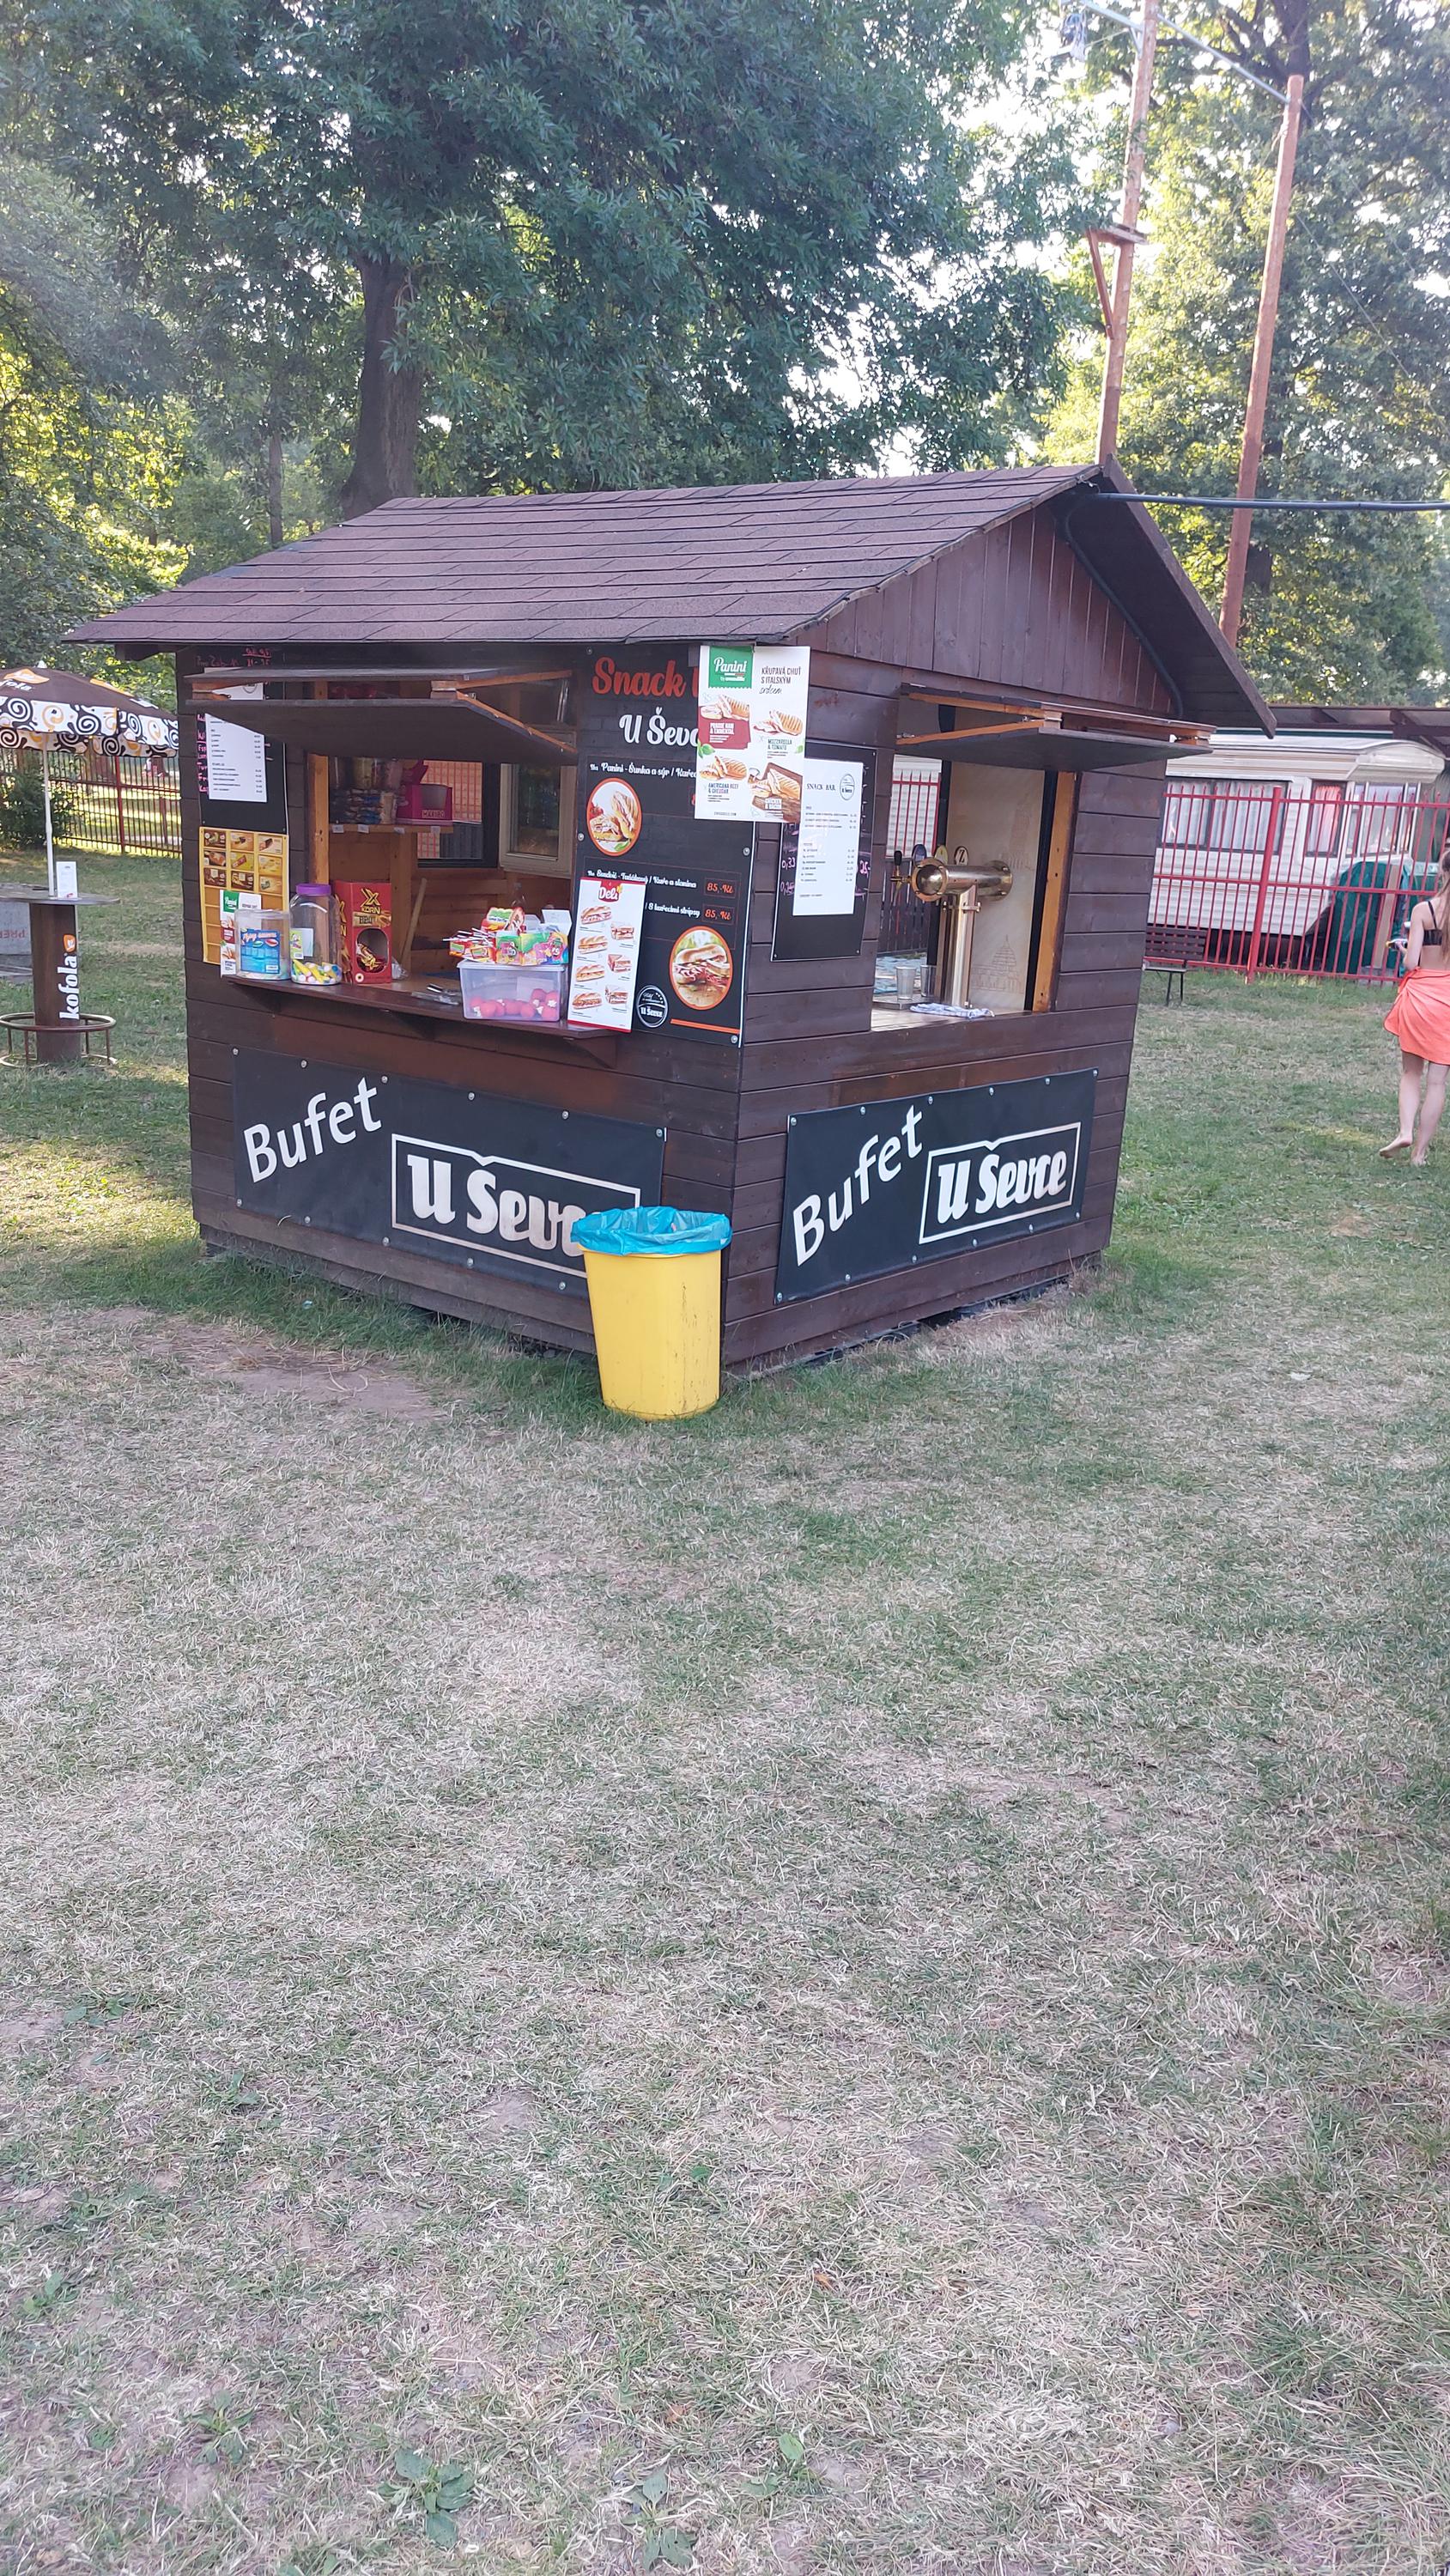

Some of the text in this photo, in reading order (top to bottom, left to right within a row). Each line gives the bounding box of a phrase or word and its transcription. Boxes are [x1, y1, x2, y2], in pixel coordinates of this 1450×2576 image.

[592, 657, 686, 697] Snack
[714, 657, 747, 672] Panini
[619, 714, 642, 744] U
[57, 955, 80, 1020] kofola
[243, 1078, 382, 1182] Bufet
[792, 1104, 923, 1267] Bufet
